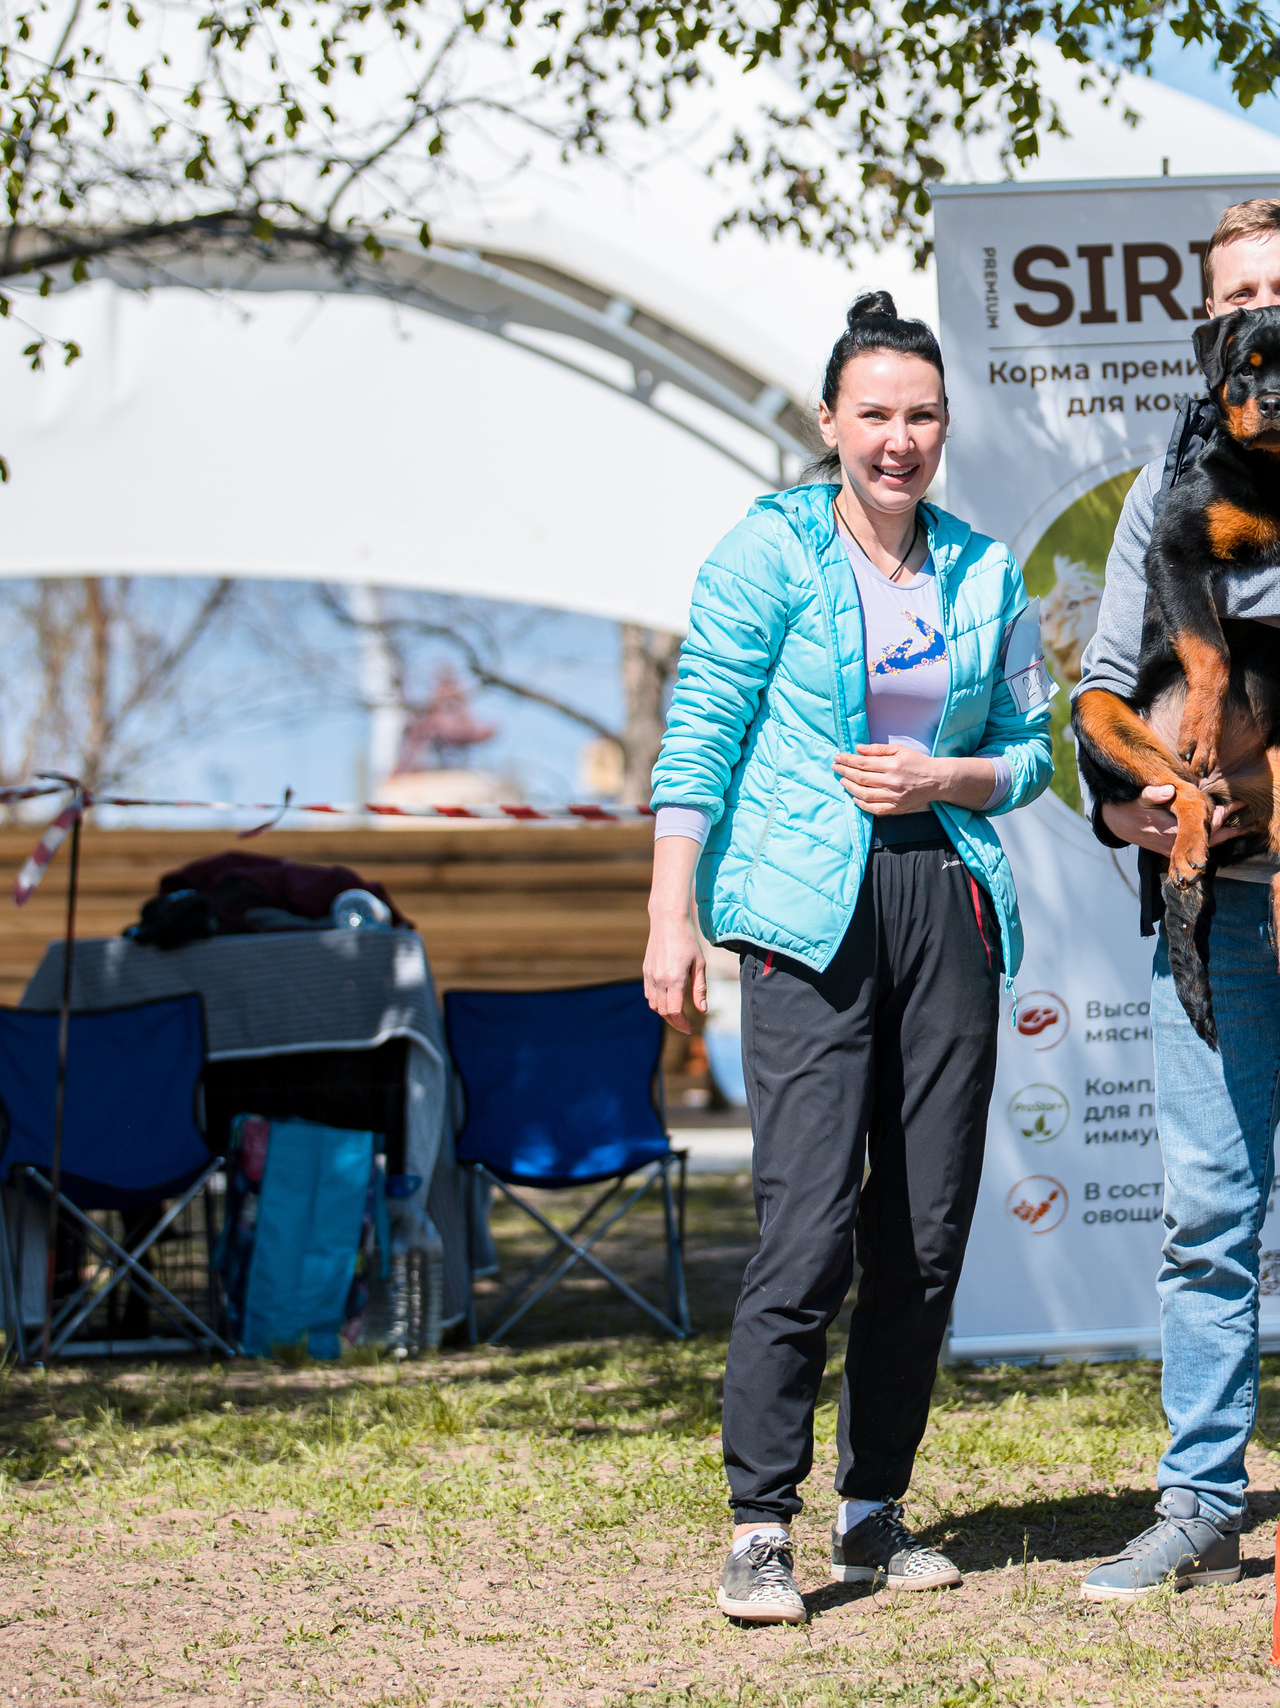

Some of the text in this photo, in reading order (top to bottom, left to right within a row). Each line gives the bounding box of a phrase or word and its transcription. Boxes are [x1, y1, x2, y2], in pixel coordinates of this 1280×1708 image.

[983, 246, 999, 329] PREMIUM
[989, 358, 1204, 388] Корма преми
[1067, 395, 1125, 417] для
[1086, 1001, 1150, 1019] Высо
[1085, 1025, 1152, 1043] мясн
[1085, 1077, 1155, 1096] Комп
[1083, 1104, 1130, 1123] для
[1084, 1126, 1159, 1146] имму
[1085, 1182, 1101, 1200] В
[1107, 1182, 1164, 1199] сост
